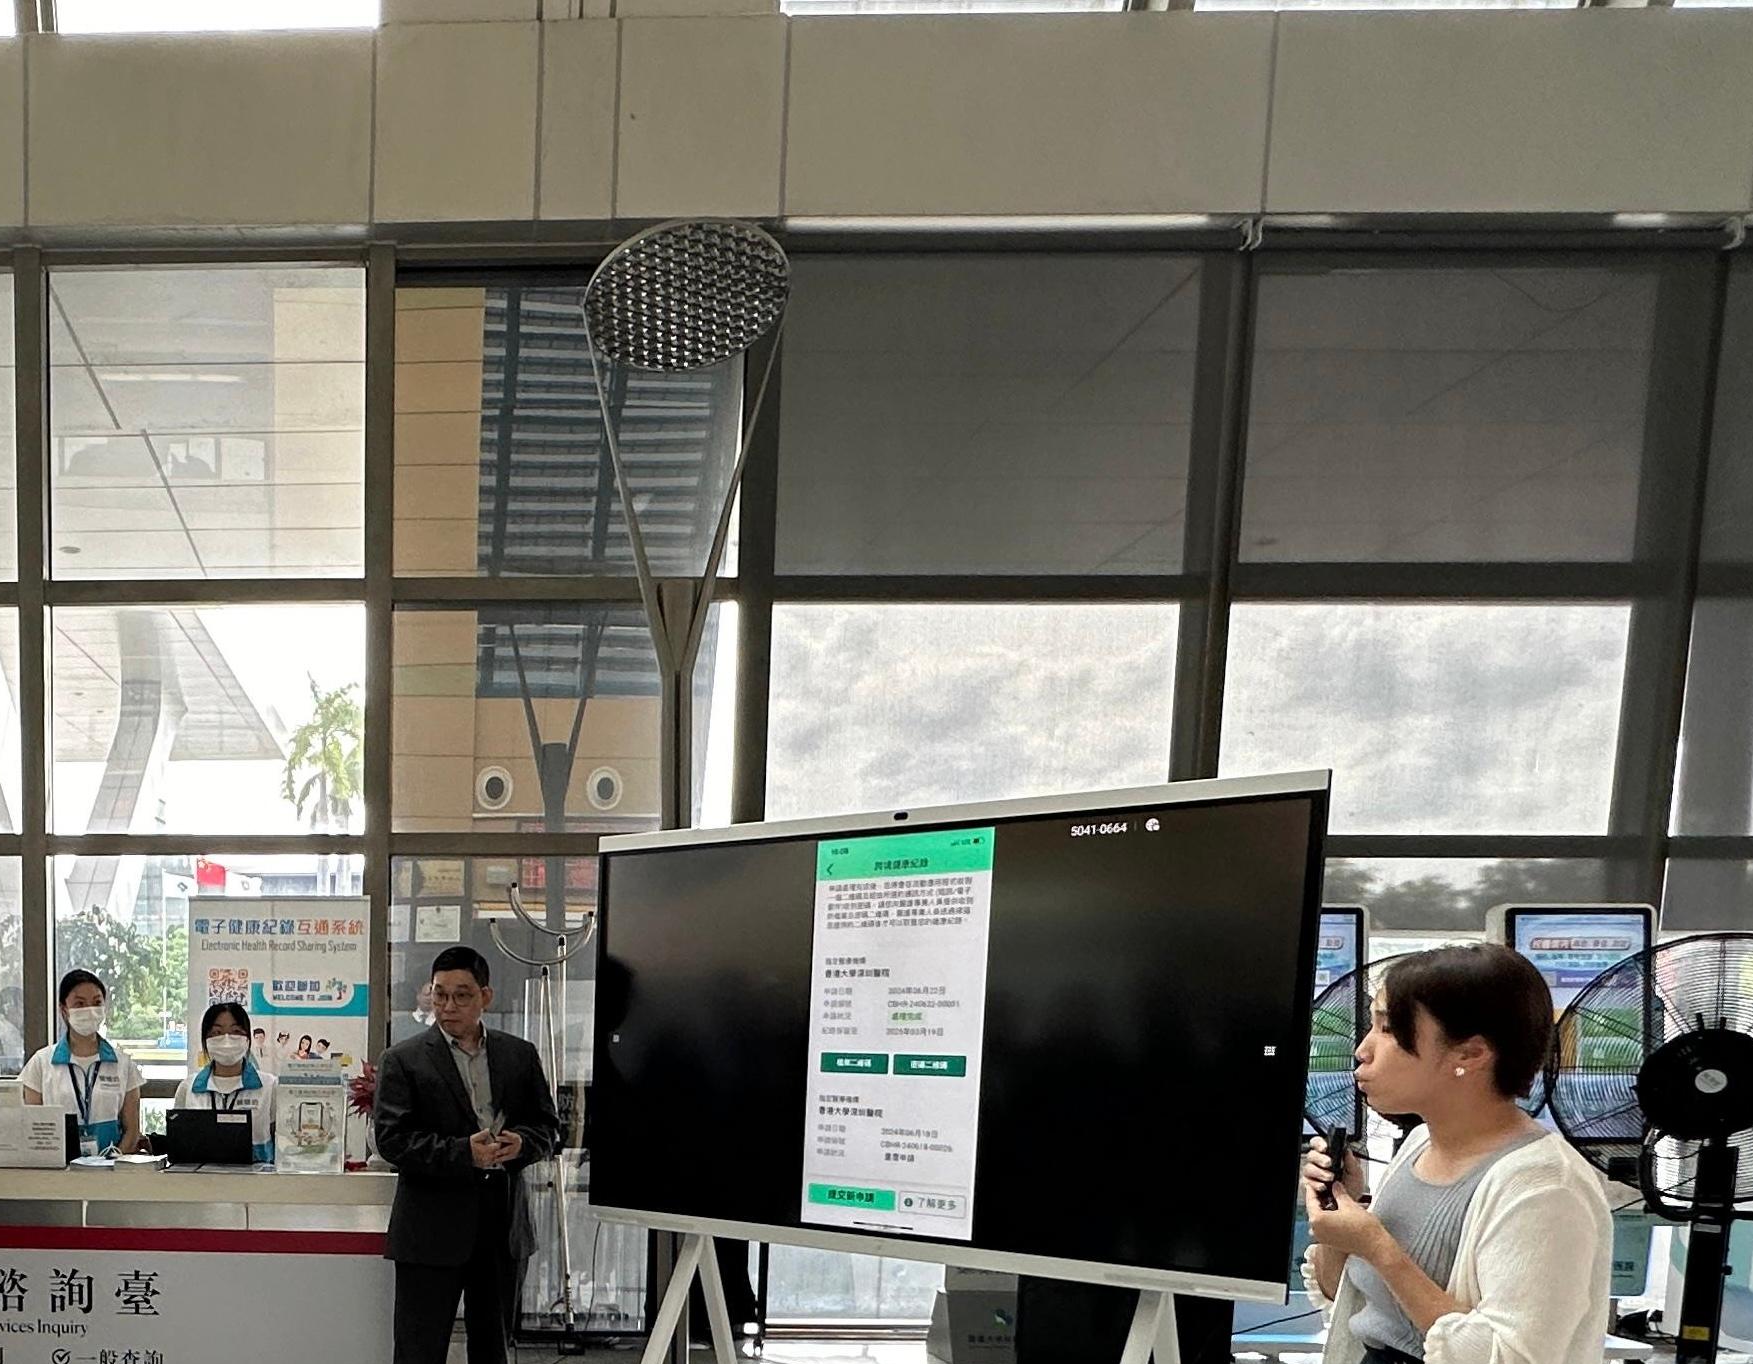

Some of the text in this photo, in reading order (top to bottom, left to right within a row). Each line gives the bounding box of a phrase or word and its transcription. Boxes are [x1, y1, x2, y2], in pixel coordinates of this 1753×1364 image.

[1071, 822, 1128, 837] 5041-0664
[195, 919, 365, 936] 電子健康紀錄互通系統
[201, 940, 357, 954] Electronic Health Record Sharing System
[917, 1197, 957, 1211] 了解更多
[37, 1319, 88, 1338] Inquiry
